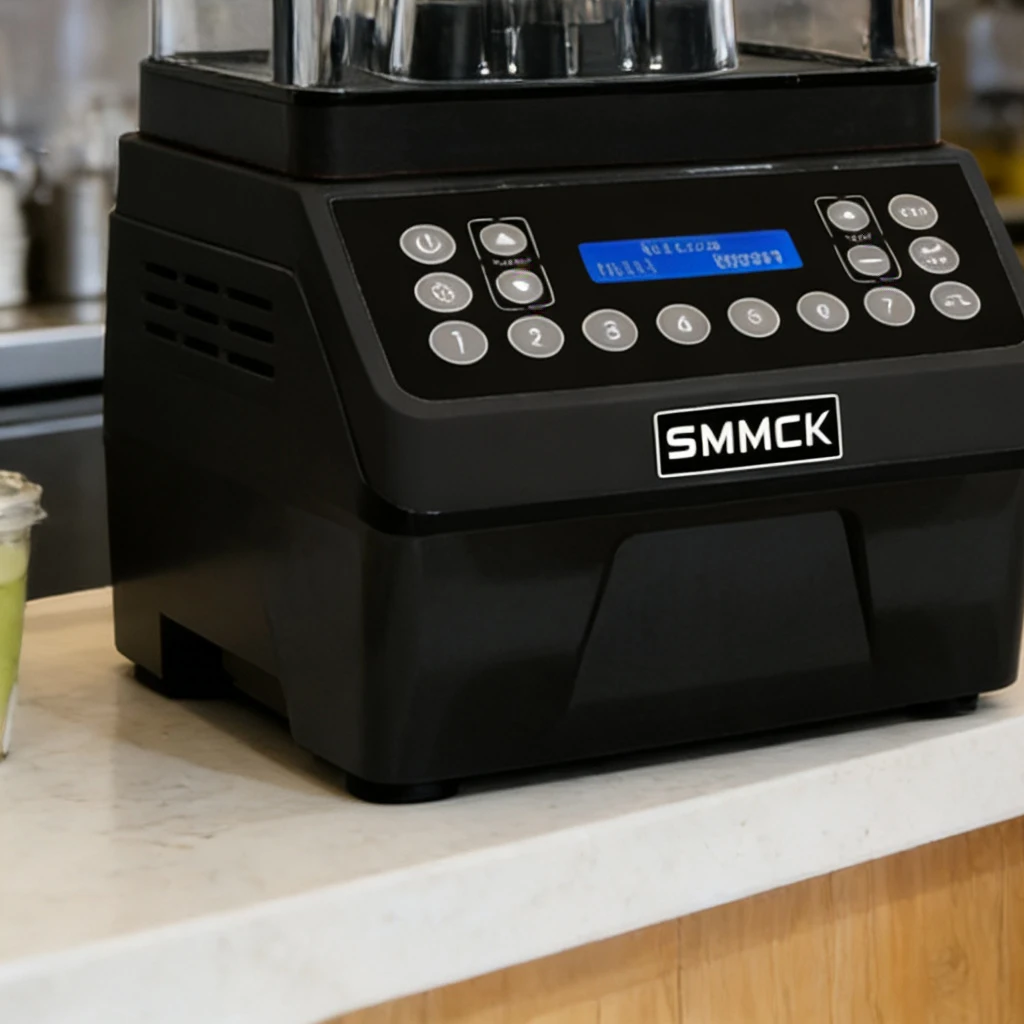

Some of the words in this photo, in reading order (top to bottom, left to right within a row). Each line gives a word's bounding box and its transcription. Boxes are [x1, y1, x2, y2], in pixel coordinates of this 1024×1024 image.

[451, 330, 465, 355] 1
[528, 327, 543, 348] 2
[881, 297, 893, 315] 7
[666, 409, 833, 460] SMMCK
